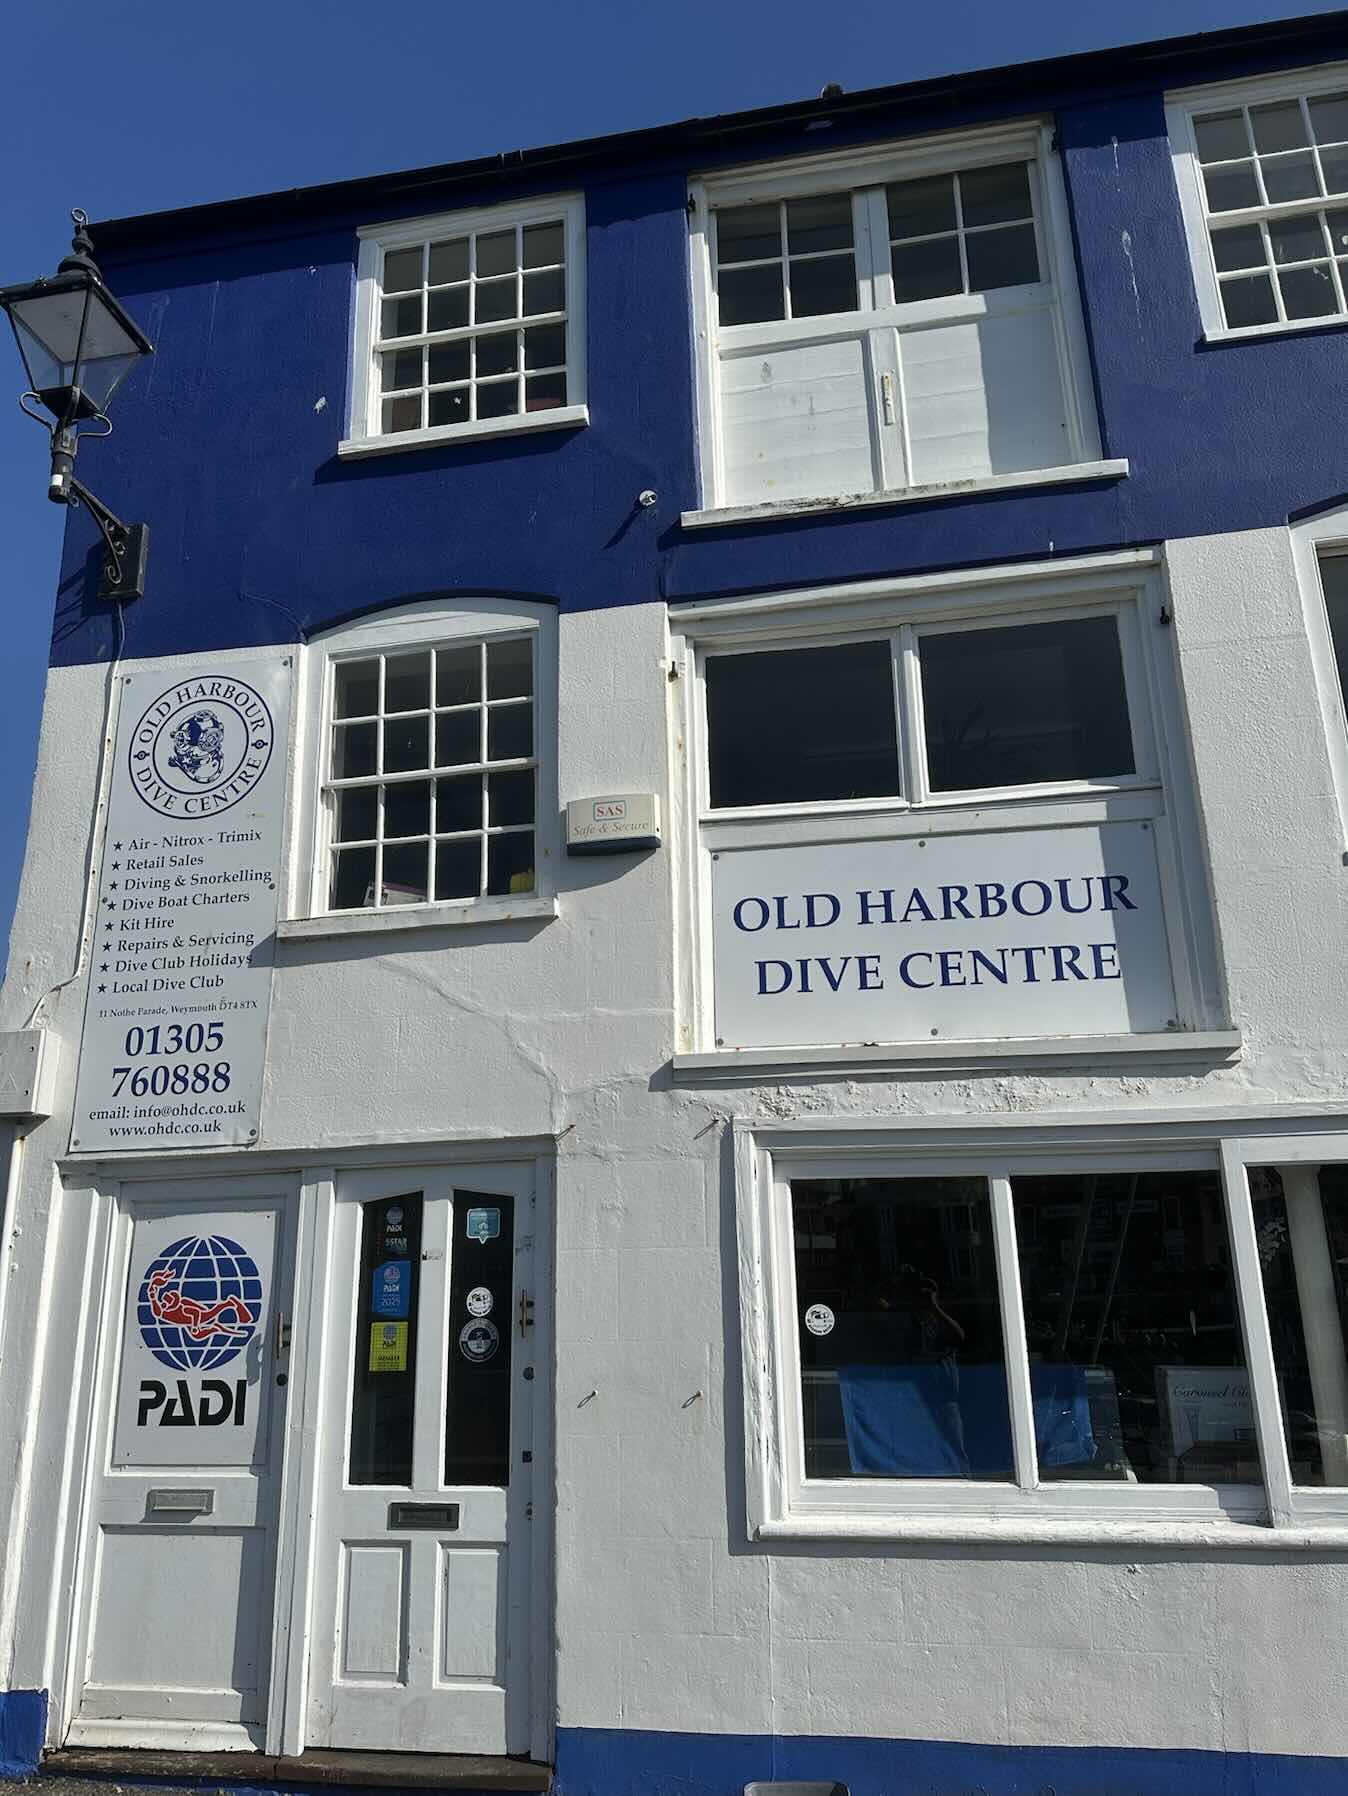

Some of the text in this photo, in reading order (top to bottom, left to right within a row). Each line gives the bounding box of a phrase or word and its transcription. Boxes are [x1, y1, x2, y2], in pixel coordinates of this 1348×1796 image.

[139, 682, 265, 744] OLD HARBOUR
[137, 758, 262, 813] DIVE CENTRE
[597, 805, 623, 817] SAS
[574, 822, 648, 837] Safe & Secure
[128, 839, 149, 851] Air
[162, 835, 204, 848] Nitrox
[218, 830, 262, 843] Trimix
[127, 855, 204, 870] Retail Sales
[124, 870, 272, 891] Diving & Snorkelling
[123, 892, 250, 911] Dive Boat Charters
[733, 875, 1138, 932] OLD HARBOUR
[120, 917, 175, 931] Kit Hire
[118, 932, 254, 953] Repairs & Servicing
[115, 953, 253, 972] Dive Club Holidays
[754, 943, 1121, 995] DIVE CENTRE
[112, 975, 224, 993] Local Dive Club
[110, 1009, 135, 1017] Nothe
[138, 1007, 168, 1016] Parade,
[171, 1003, 217, 1014] Weymouth
[125, 1022, 224, 1056] 01305
[112, 1062, 231, 1097] 760888
[89, 1100, 246, 1120] email: info@ohdc.co.uk
[110, 1120, 222, 1136] www.ohdc.co.uk
[137, 1380, 248, 1426] PADI
